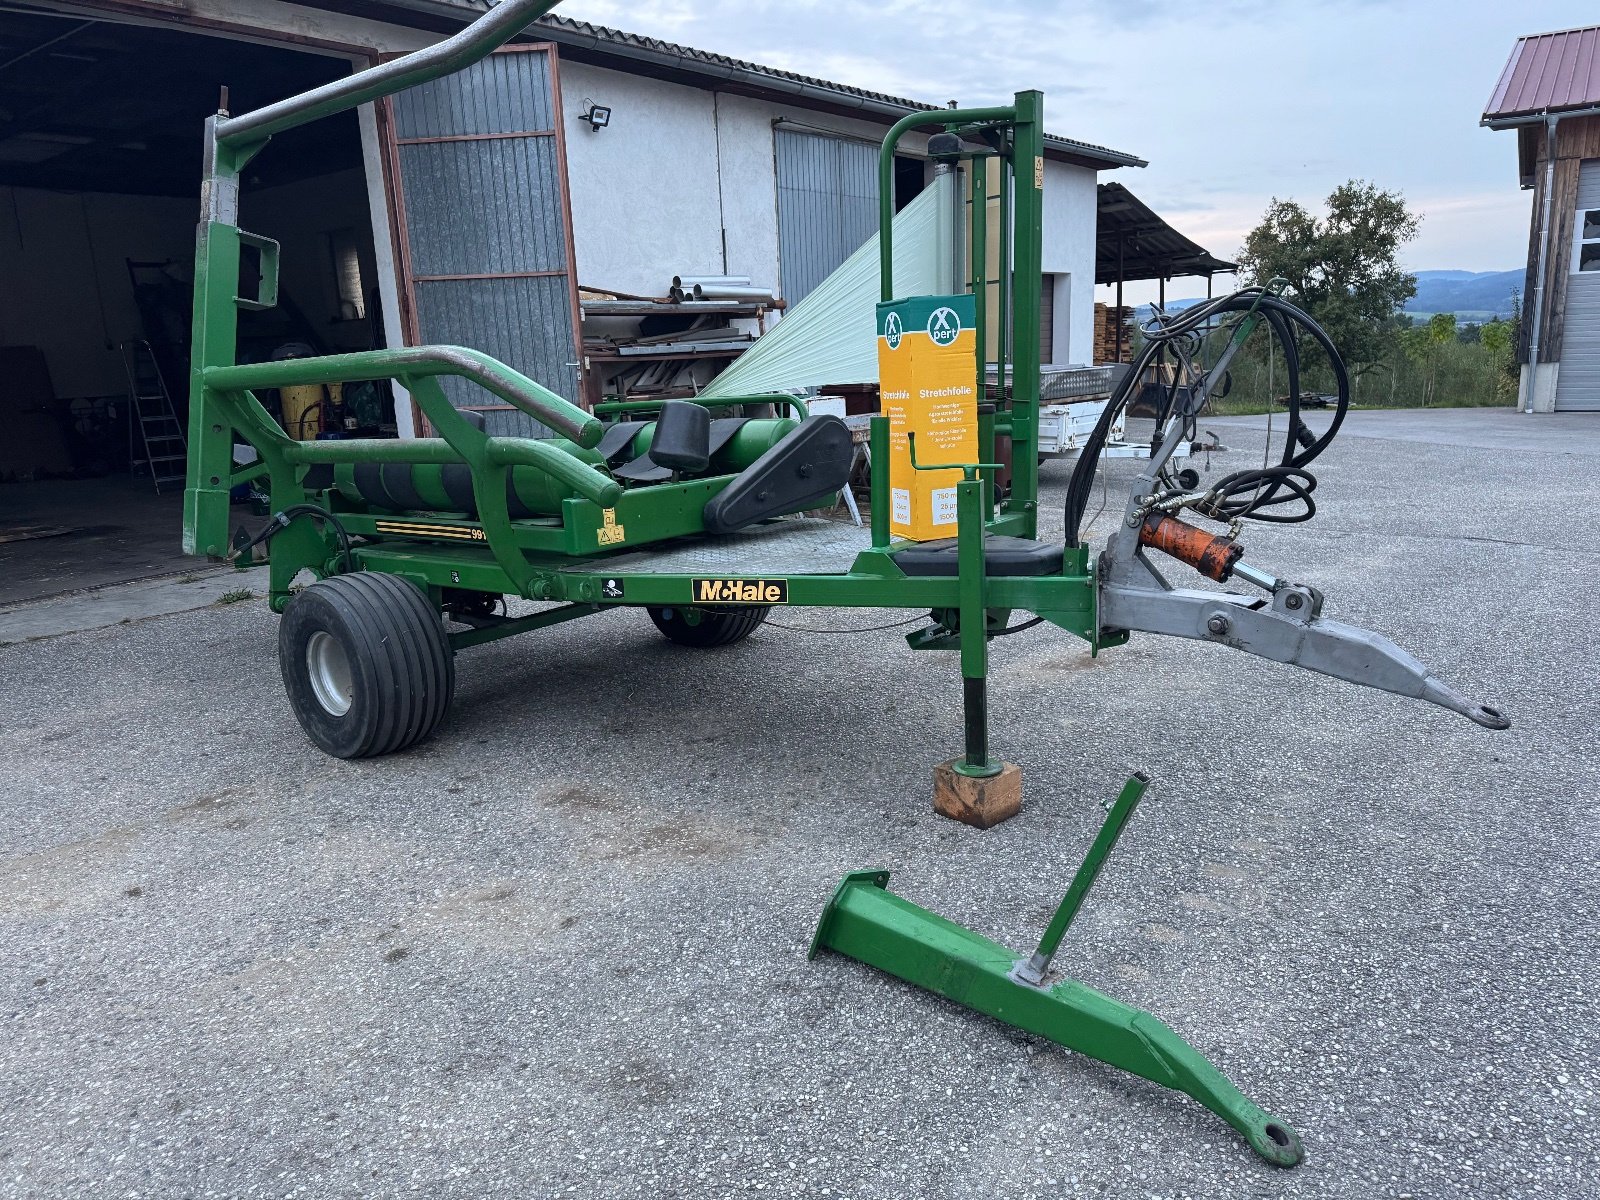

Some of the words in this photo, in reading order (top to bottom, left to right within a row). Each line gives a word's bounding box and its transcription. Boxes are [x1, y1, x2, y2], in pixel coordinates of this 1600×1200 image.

[933, 328, 957, 341] pert
[919, 386, 972, 399] Stretchfolie
[700, 580, 781, 602] McHale
